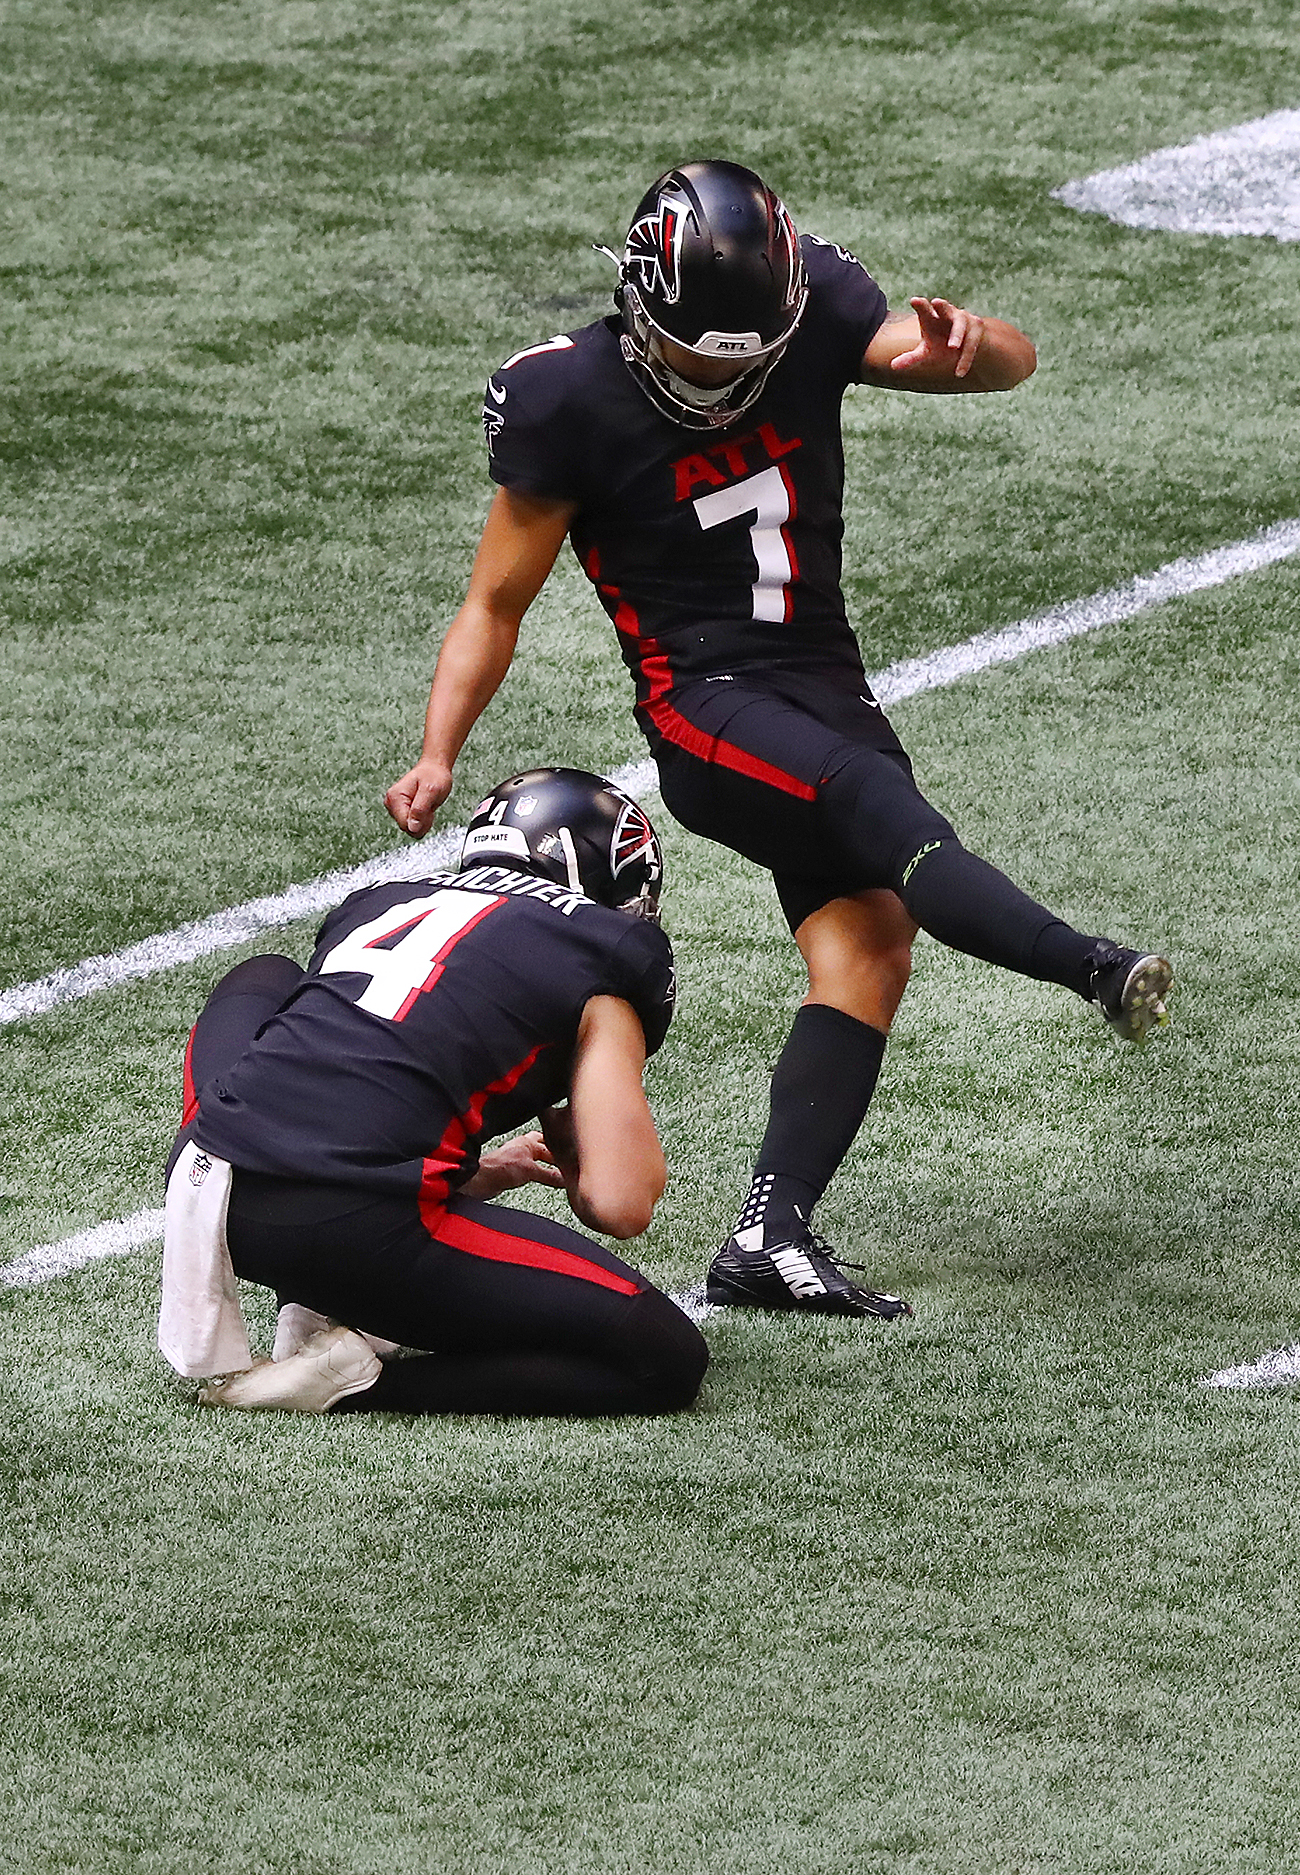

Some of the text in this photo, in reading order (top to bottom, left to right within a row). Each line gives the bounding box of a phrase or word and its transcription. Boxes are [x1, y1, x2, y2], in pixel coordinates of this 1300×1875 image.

[716, 341, 748, 350] ATL
[668, 422, 803, 502] ATL
[692, 461, 799, 624] 7
[473, 833, 508, 843] STOP HATE
[488, 800, 509, 826] 4
[319, 888, 509, 1022] 4
[769, 1247, 829, 1300] NIKE
